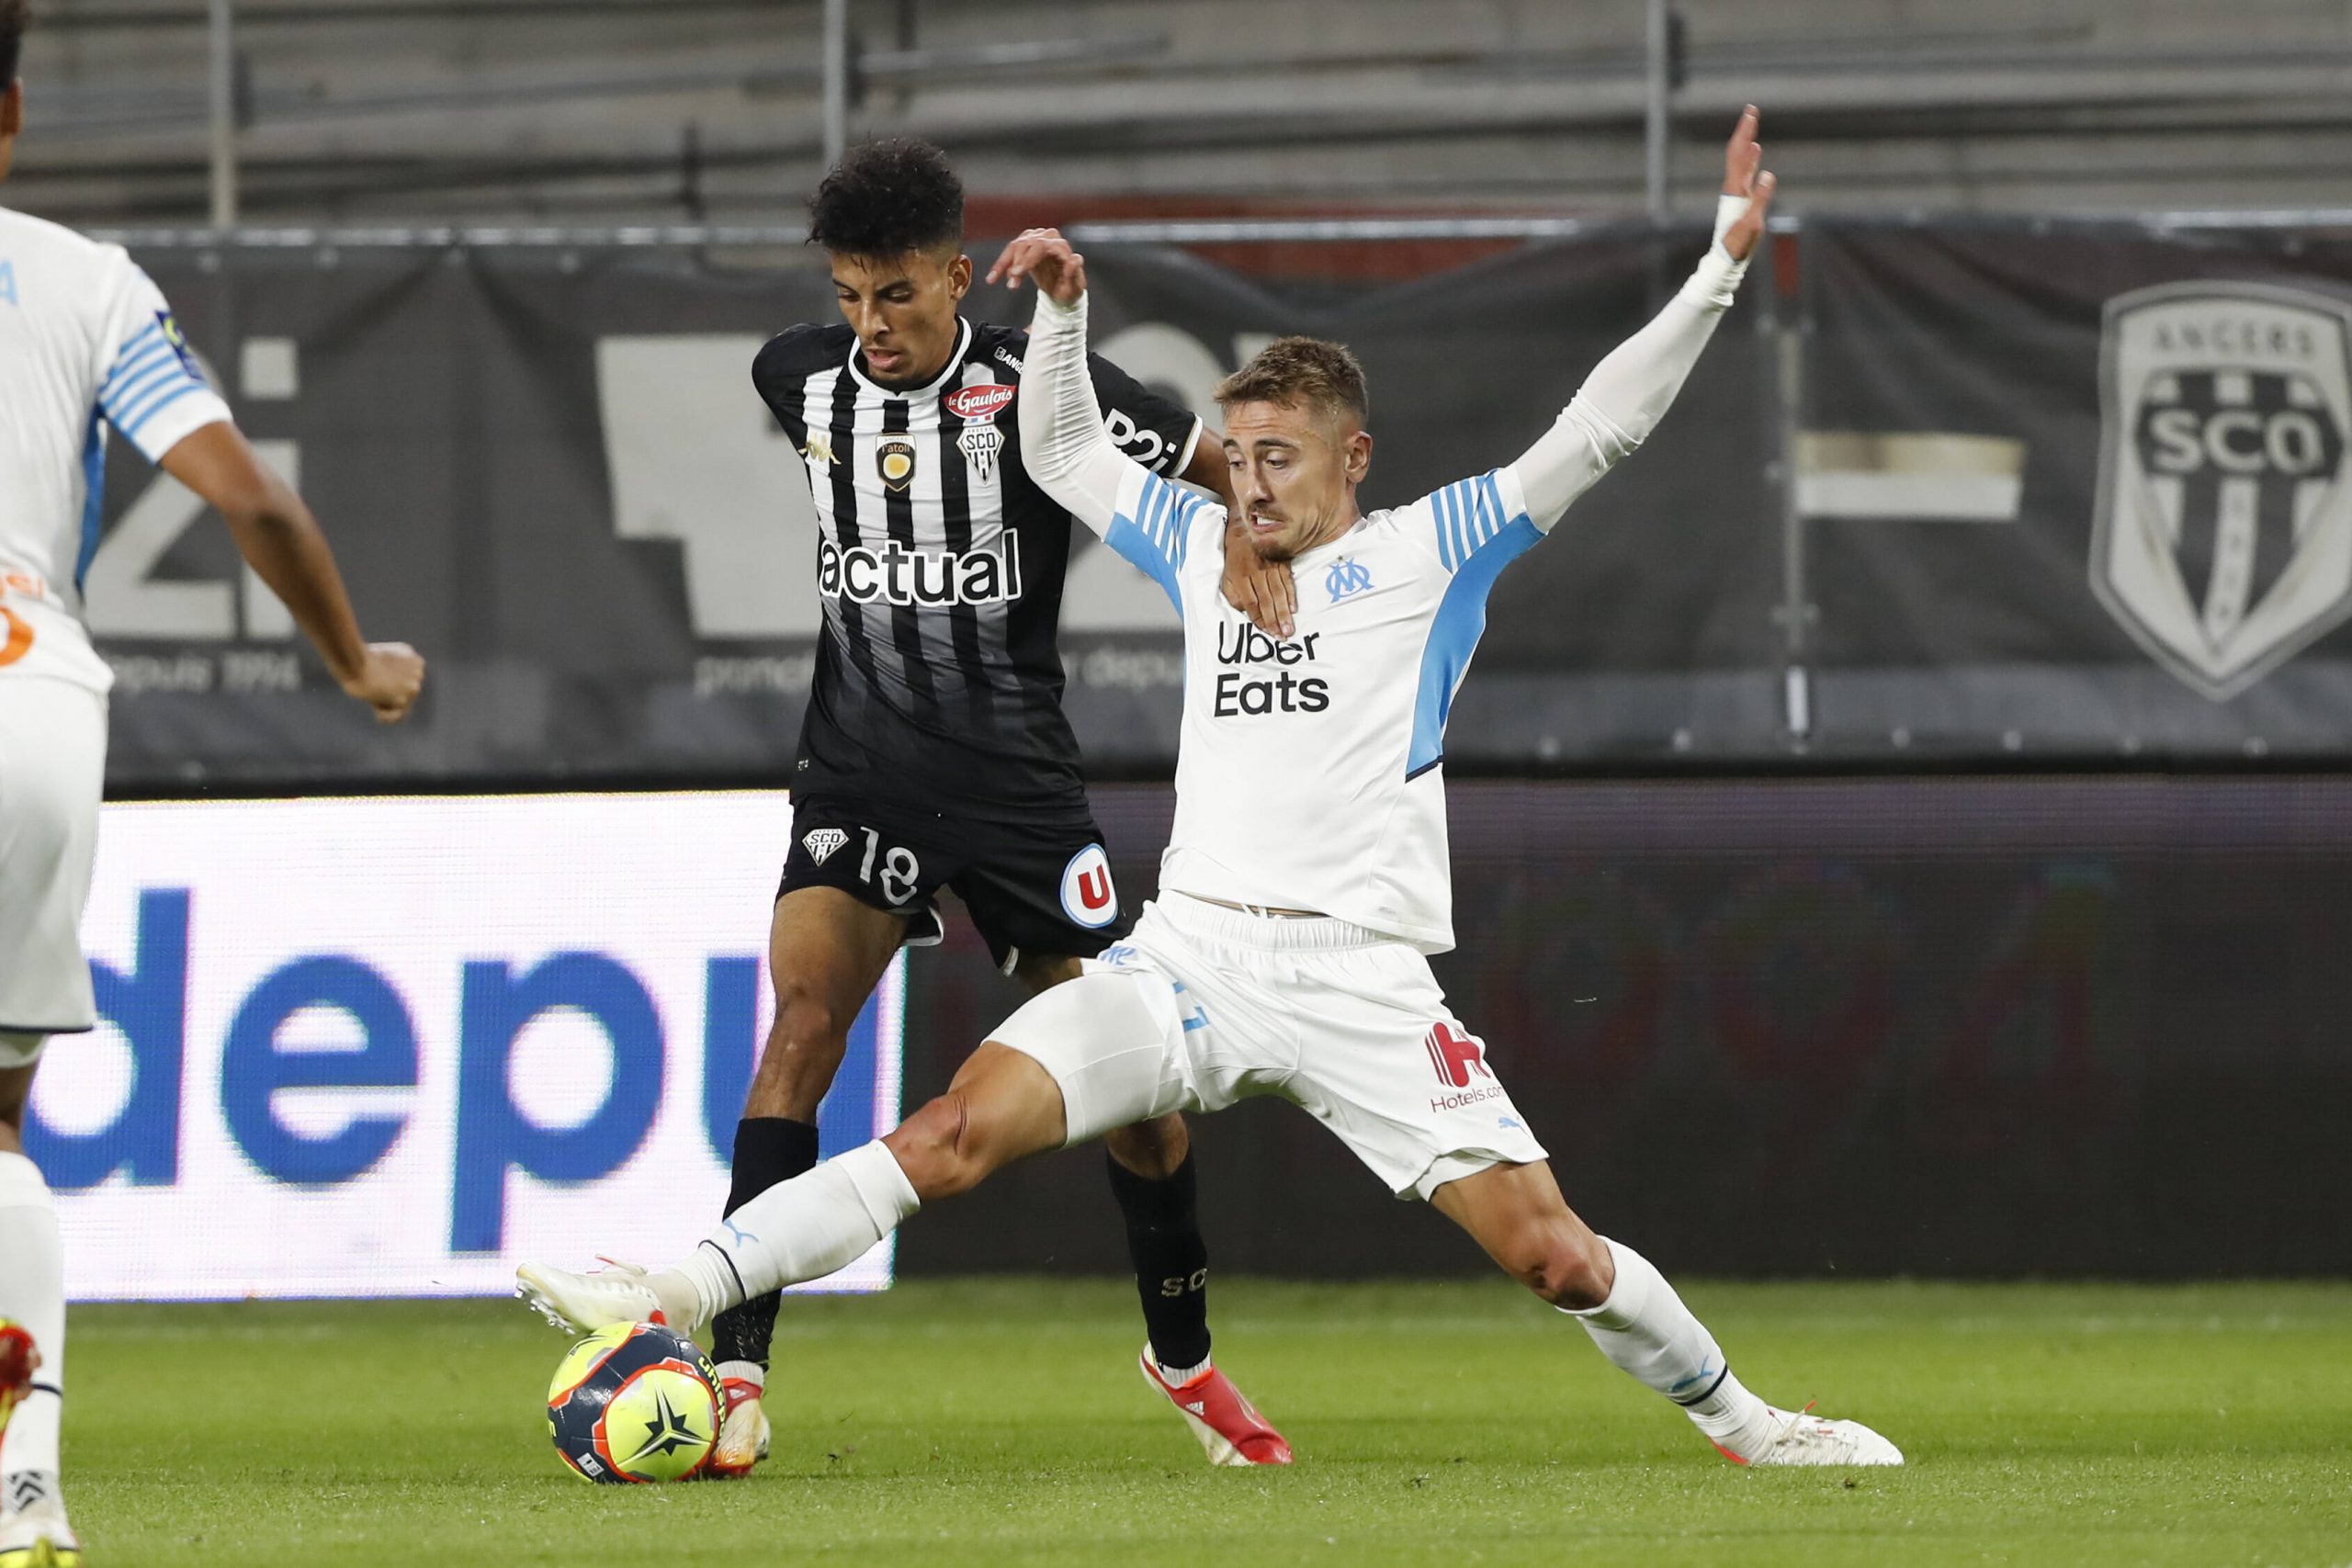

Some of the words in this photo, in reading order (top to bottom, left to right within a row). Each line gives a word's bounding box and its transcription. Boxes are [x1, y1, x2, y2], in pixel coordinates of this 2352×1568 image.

[956, 389, 1013, 413] Gaulois
[966, 433, 996, 450] SCO
[2147, 409, 2324, 475] SCO
[819, 528, 1022, 606] actual
[1217, 621, 1320, 665] Uber
[1214, 671, 1330, 717] Eats
[809, 832, 841, 845] SCO
[859, 826, 920, 906] 18
[1078, 863, 1111, 910] U
